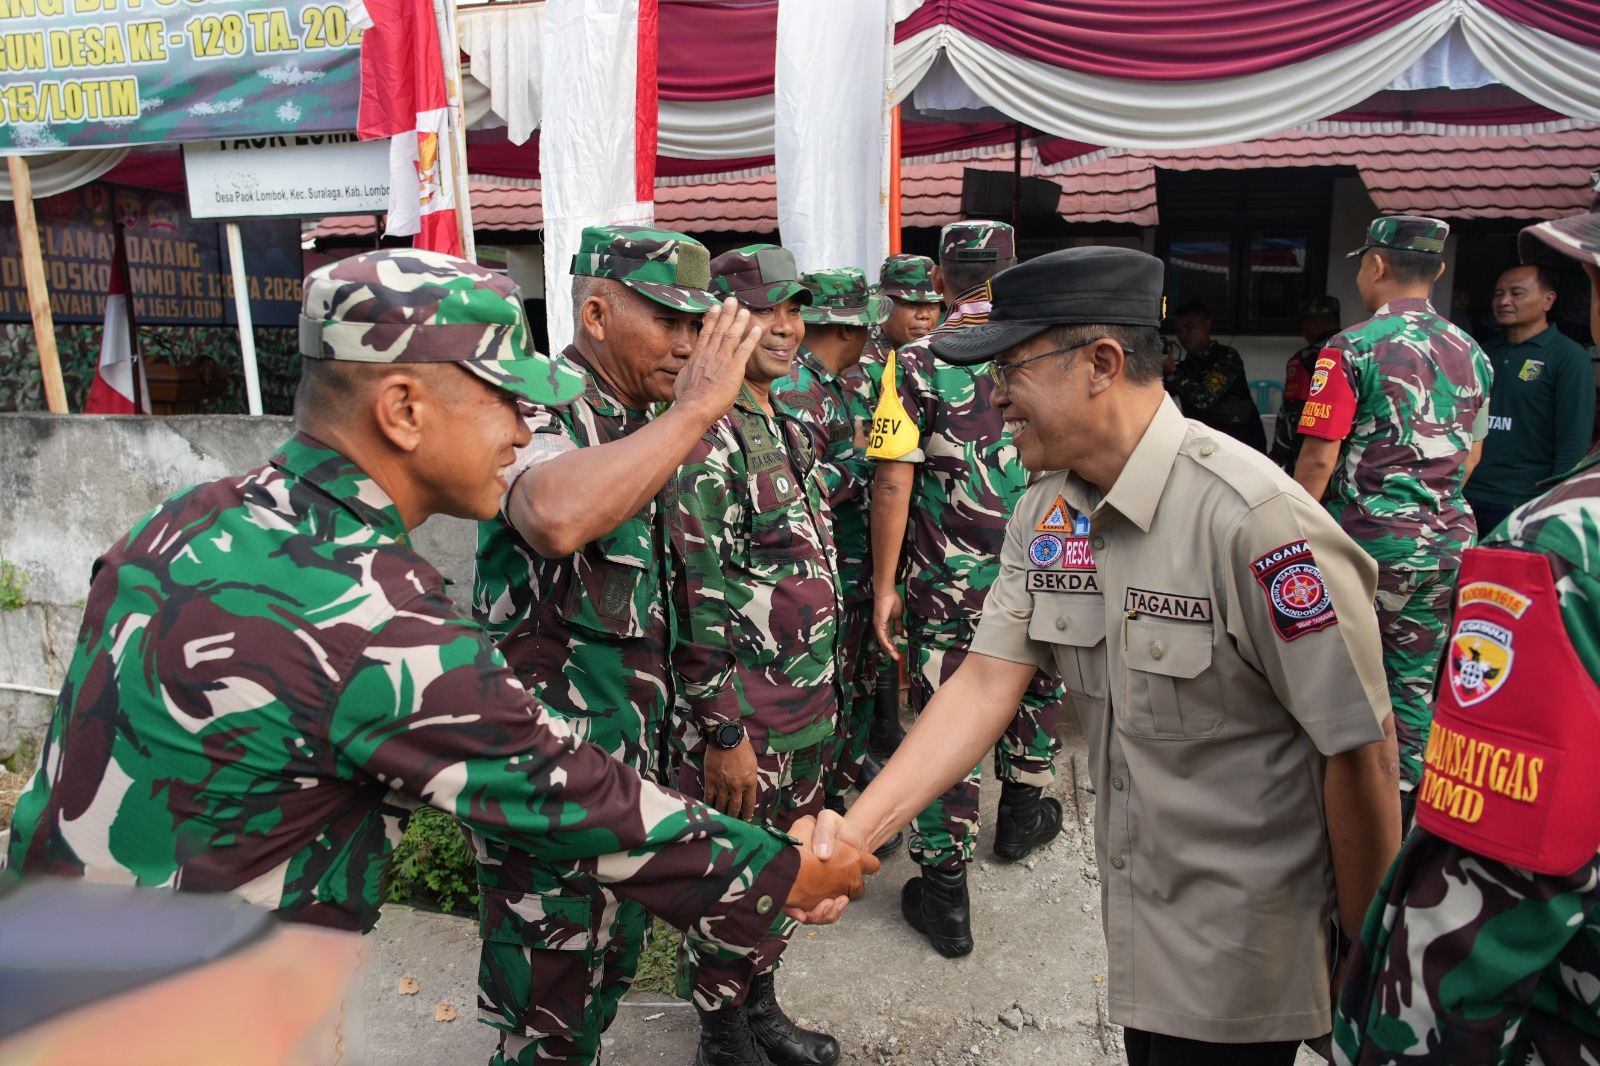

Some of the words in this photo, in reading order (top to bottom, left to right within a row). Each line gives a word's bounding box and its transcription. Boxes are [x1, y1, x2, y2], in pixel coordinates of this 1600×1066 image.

[49, 25, 126, 68] DESA
[127, 22, 167, 62] KE
[186, 14, 245, 57] 128
[247, 11, 299, 52] TA.
[0, 78, 138, 123] 15/LOTIM
[215, 191, 234, 203] Desa
[235, 190, 255, 203] Paok
[256, 188, 289, 201] Lombok,
[290, 187, 307, 200] Kec.
[308, 186, 344, 201] Suralaga,
[345, 185, 363, 198] Kab.
[124, 235, 201, 268] DATANG
[180, 270, 203, 298] KE
[14, 290, 93, 315] WAYAH
[1065, 540, 1096, 566] RESC
[1256, 542, 1312, 571] TAGANA
[1032, 573, 1099, 591] SEKDA
[1278, 566, 1301, 582] SIAGA
[1129, 591, 1206, 619] TAGANA
[1273, 583, 1288, 612] TARUNA
[1288, 597, 1329, 616] INDONESIA
[1420, 768, 1485, 824] TMMD
